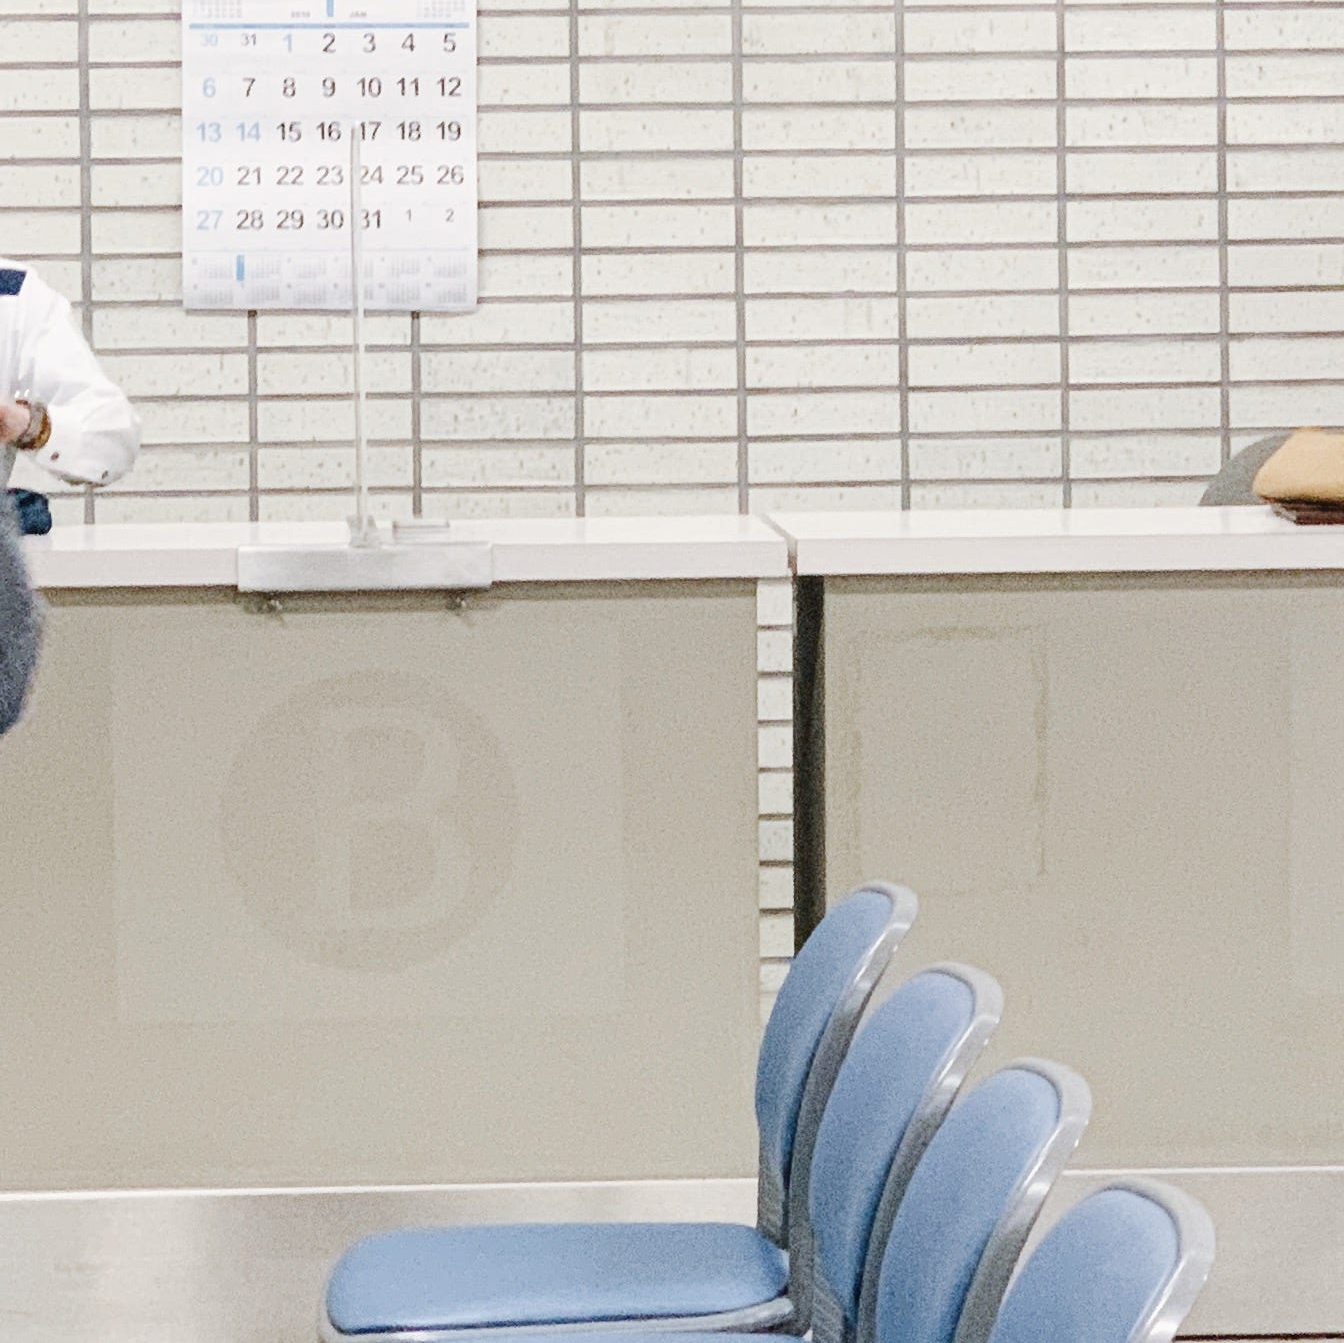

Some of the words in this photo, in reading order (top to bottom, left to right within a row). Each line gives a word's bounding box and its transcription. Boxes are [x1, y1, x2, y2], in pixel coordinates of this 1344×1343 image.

[200, 33, 218, 46] 30
[241, 33, 257, 46] 31
[284, 33, 293, 52] 1
[322, 33, 337, 53] 2
[363, 33, 376, 53] 3
[401, 33, 416, 53] 4
[443, 33, 456, 52] 5
[202, 77, 216, 98] 6
[243, 78, 256, 97] 7
[283, 78, 296, 97] 8
[322, 78, 336, 97] 9
[357, 78, 381, 97] 10
[397, 78, 419, 96] 11
[438, 78, 461, 96] 12
[196, 121, 222, 142] 13
[236, 121, 261, 141] 14
[277, 122, 301, 142] 15
[317, 122, 341, 140] 16
[359, 121, 381, 141] 17
[397, 121, 421, 140] 18
[437, 121, 461, 140] 19
[197, 166, 223, 186] 20
[237, 166, 261, 185] 21
[276, 166, 304, 185] 22
[317, 166, 344, 185] 23
[359, 165, 383, 185] 24
[397, 166, 424, 184] 25
[437, 166, 464, 185] 26
[197, 210, 223, 230] 27
[237, 210, 263, 230] 28
[277, 210, 304, 229] 29
[317, 210, 344, 229] 30
[361, 209, 381, 229] 31
[405, 209, 412, 222] 1
[444, 208, 455, 222] 2
